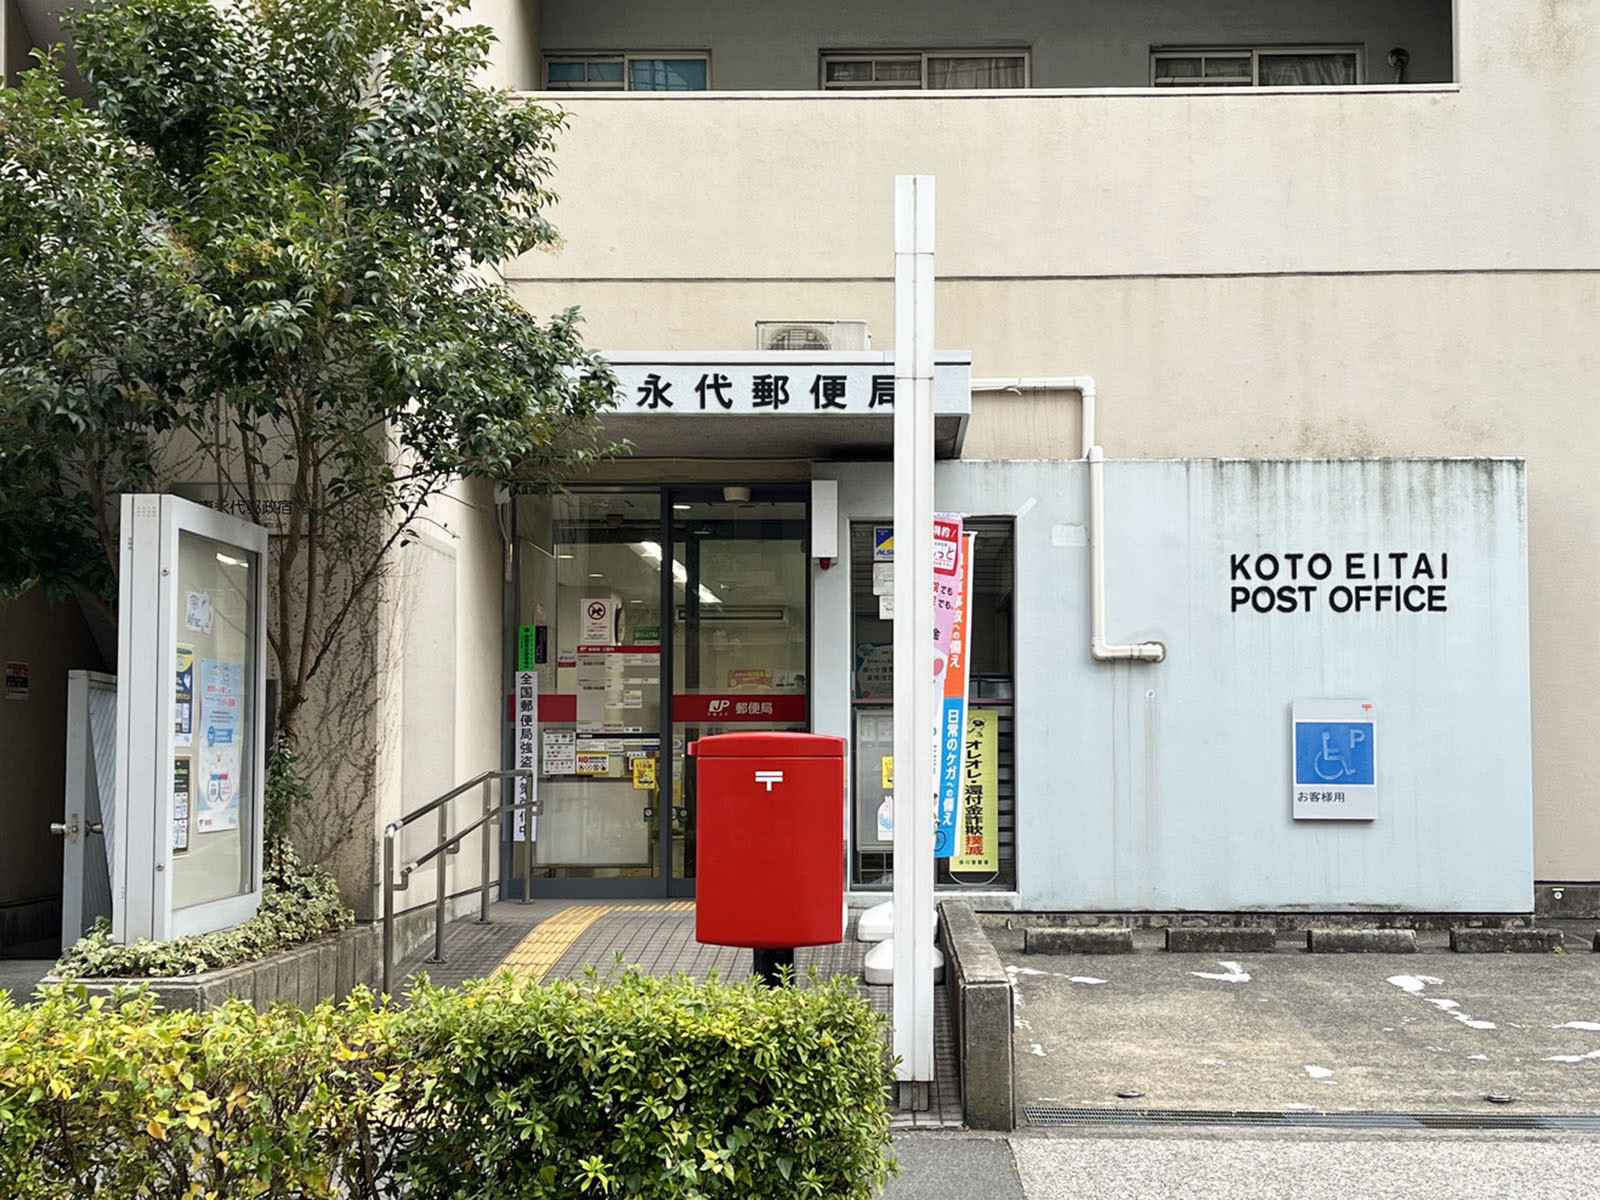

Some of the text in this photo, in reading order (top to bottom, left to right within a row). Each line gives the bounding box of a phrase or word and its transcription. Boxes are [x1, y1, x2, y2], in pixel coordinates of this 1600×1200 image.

[579, 373, 894, 410] 永代郵便局
[1230, 552, 1448, 581] KOTO EITAI
[1230, 585, 1449, 613] POST OFFICE
[735, 702, 773, 714] 郵便局
[1350, 730, 1365, 748] P
[1297, 791, 1346, 803] お客様用
